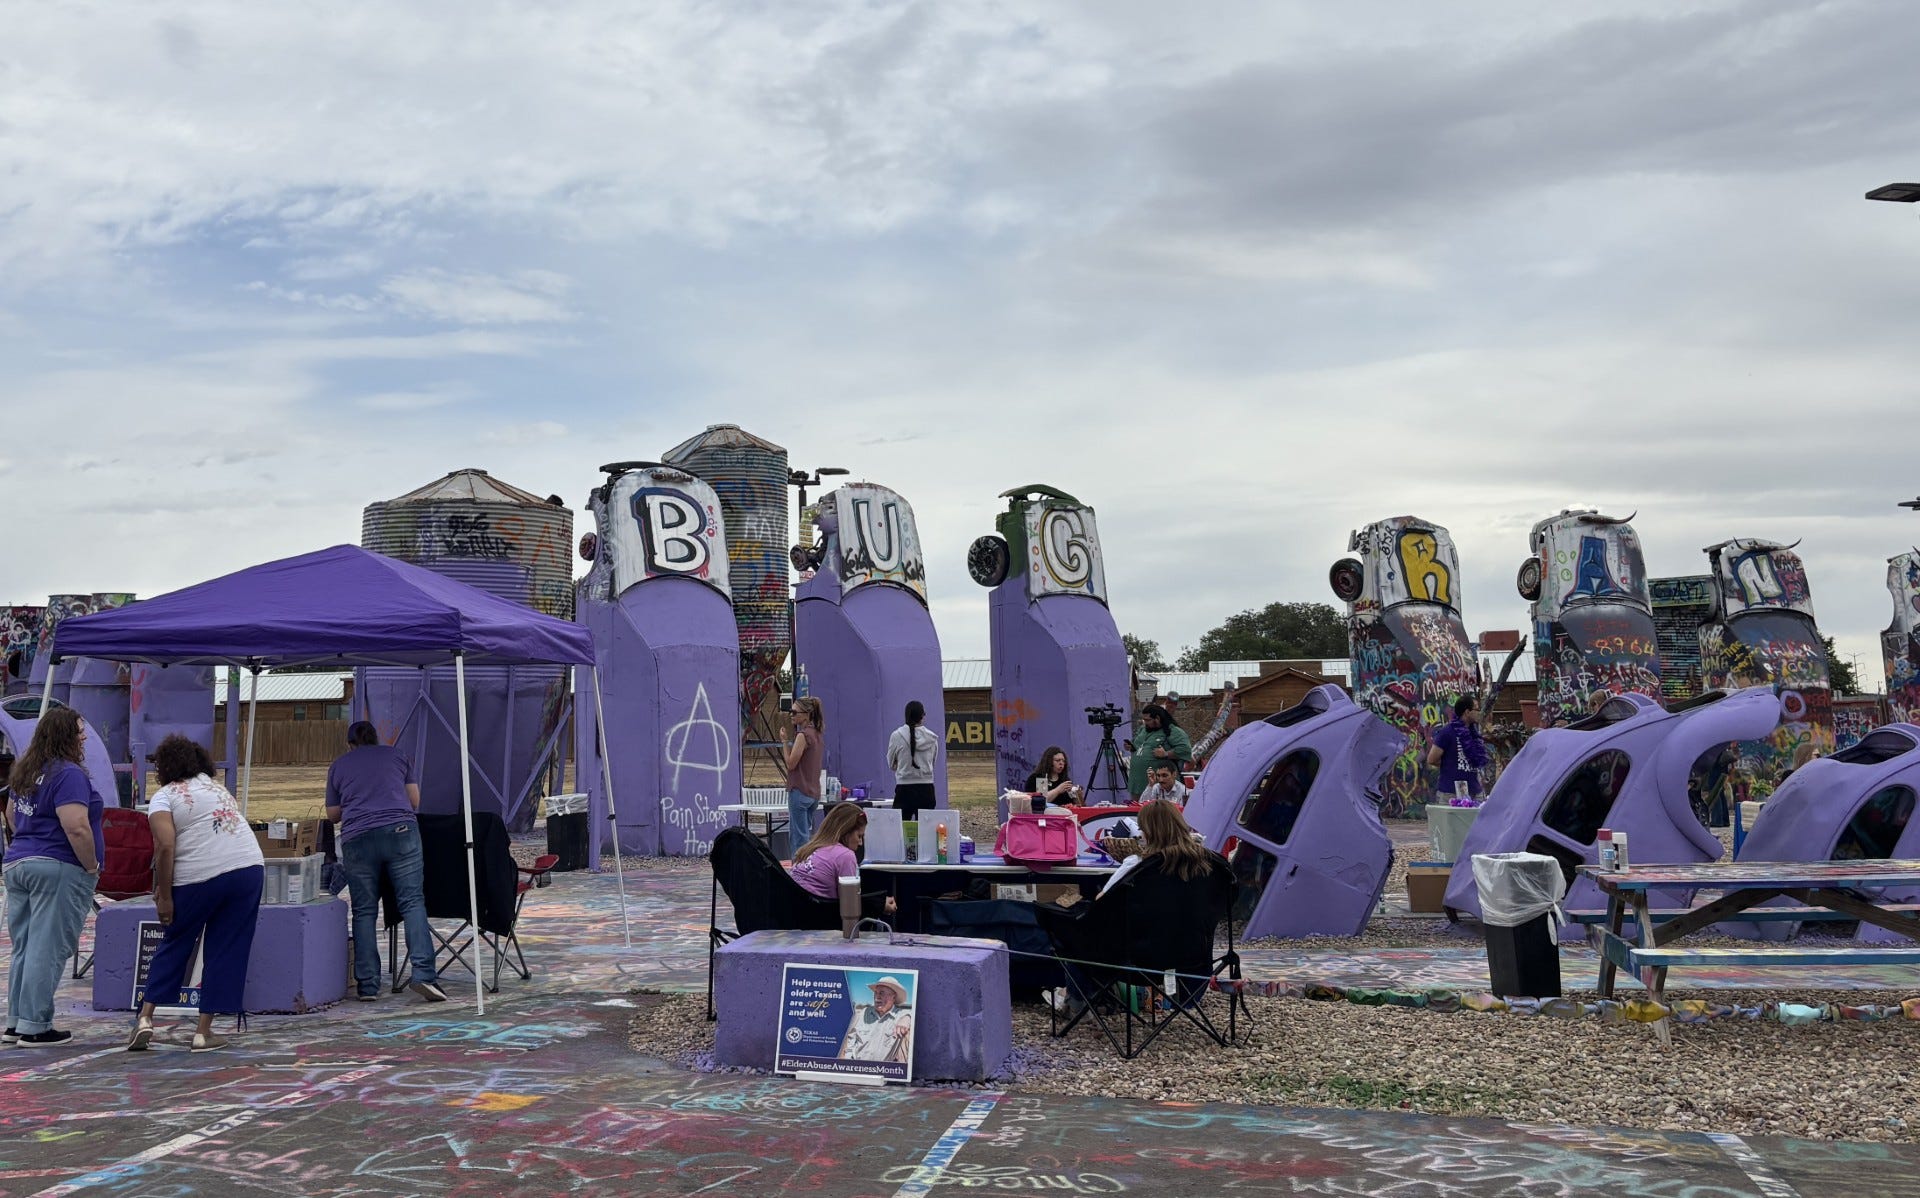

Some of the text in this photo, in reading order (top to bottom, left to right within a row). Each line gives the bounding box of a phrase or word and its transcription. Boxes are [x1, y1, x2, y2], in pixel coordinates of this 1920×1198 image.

[630, 487, 710, 577] B
[852, 499, 902, 572] U
[1039, 508, 1092, 588] G
[1395, 528, 1450, 604] R
[1569, 535, 1622, 597] A
[1733, 552, 1787, 609] N
[660, 796, 694, 829] Pain
[684, 830, 714, 855] Her
[790, 990, 842, 999] older Texans
[791, 979, 842, 989] Help ensure
[788, 1009, 805, 1017] and
[781, 1060, 903, 1075] #ElderAbuseAwarenessMonth
